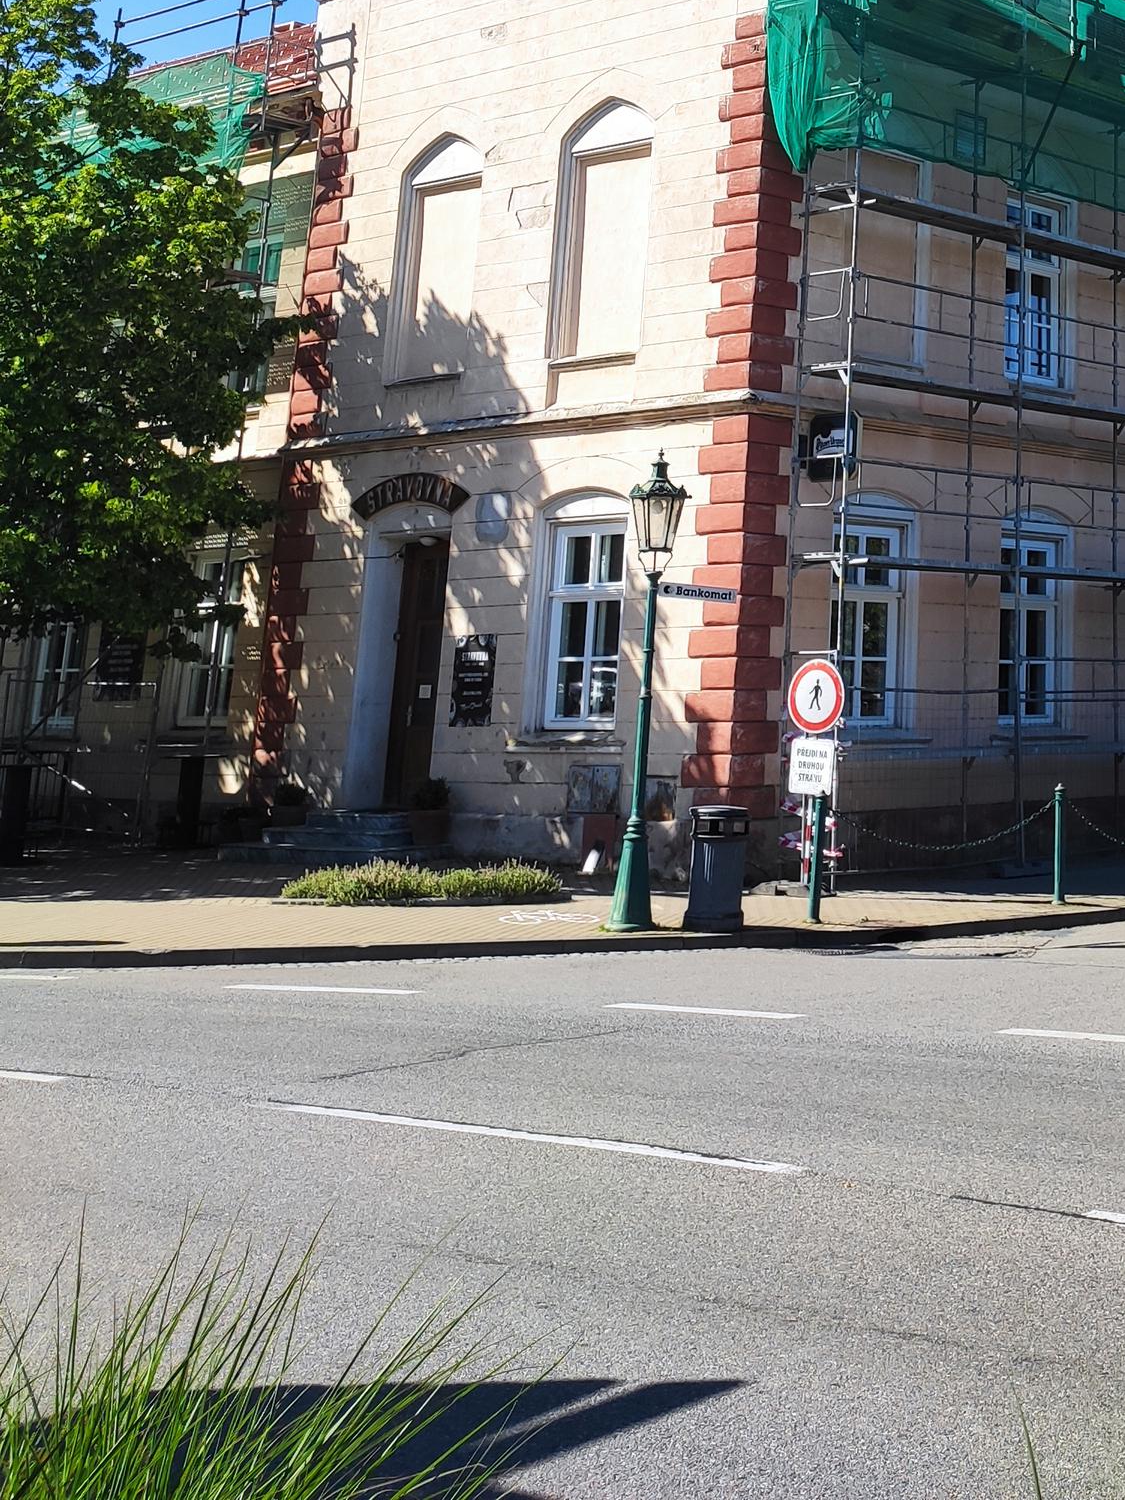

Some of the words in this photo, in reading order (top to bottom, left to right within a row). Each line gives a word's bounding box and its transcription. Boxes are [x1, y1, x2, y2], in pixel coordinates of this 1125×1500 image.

[367, 476, 454, 512] STRAVOVNA
[676, 586, 732, 601] Bankomat
[819, 749, 828, 759] NA
[798, 760, 825, 771] DRUHOU
